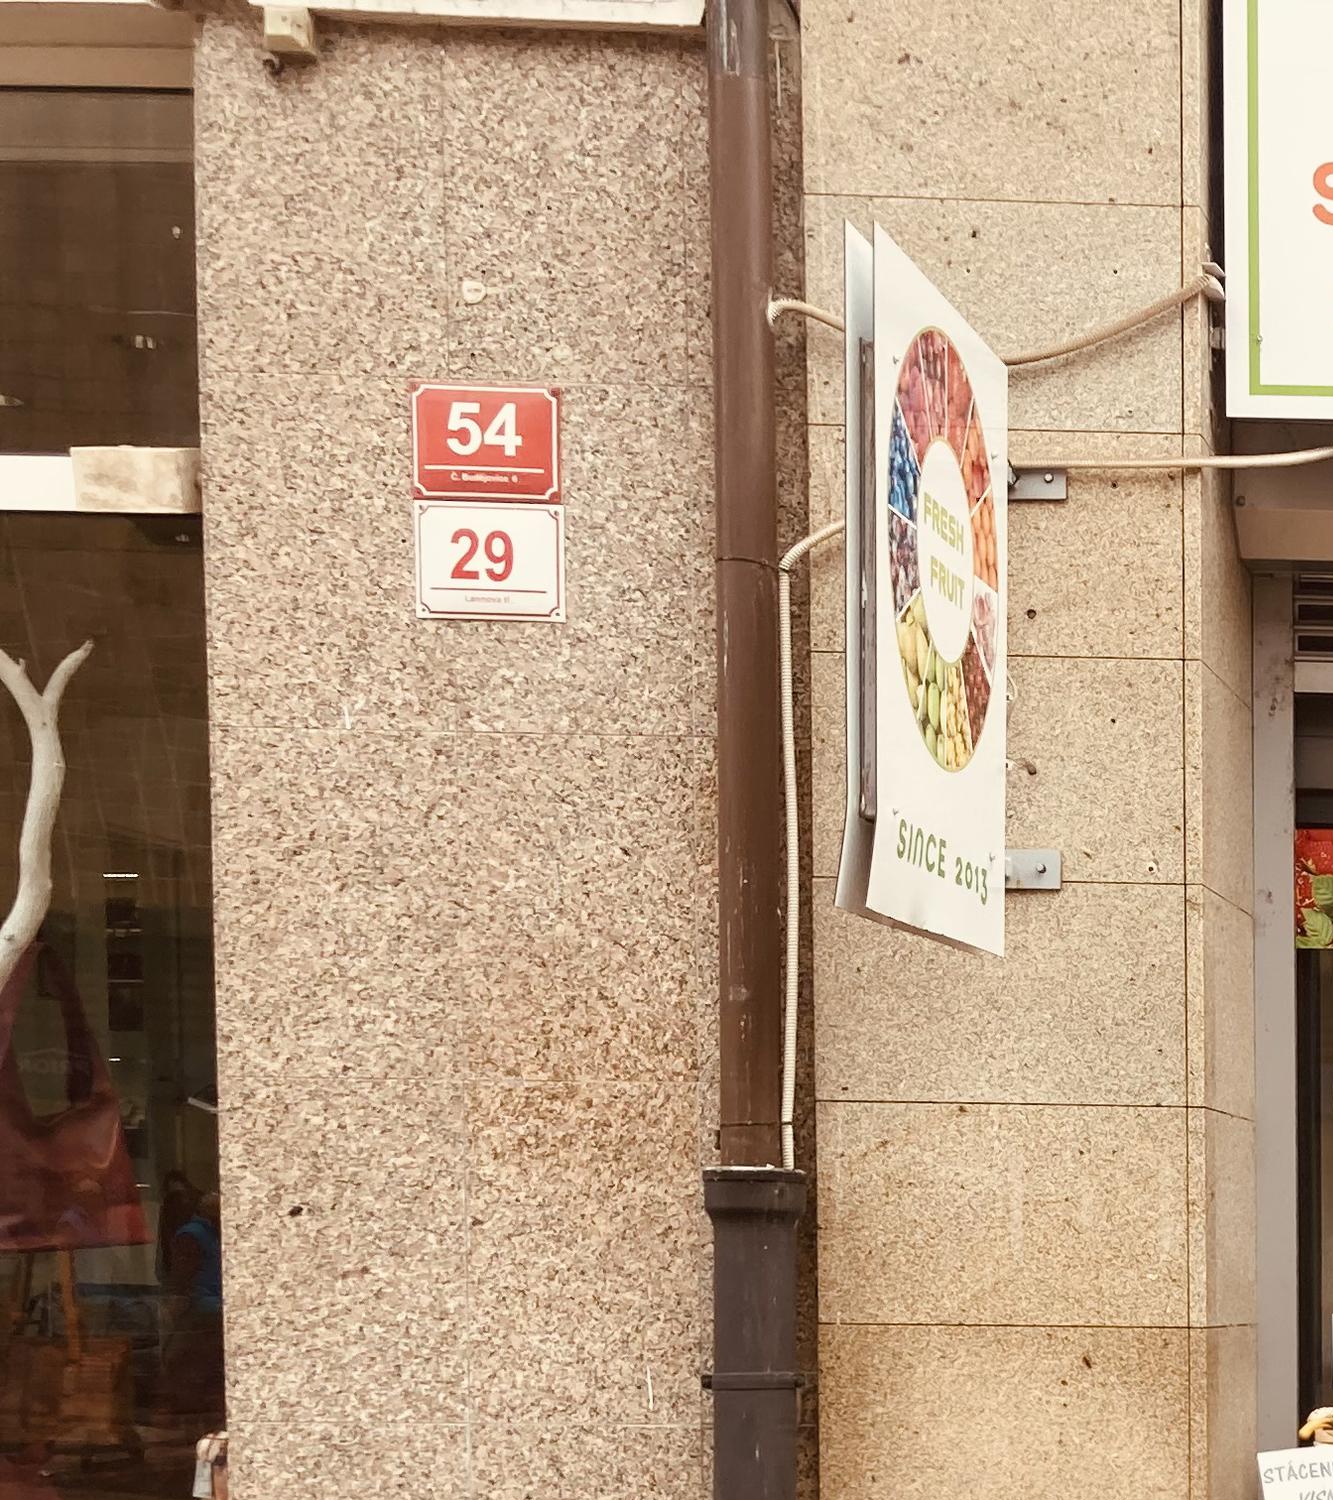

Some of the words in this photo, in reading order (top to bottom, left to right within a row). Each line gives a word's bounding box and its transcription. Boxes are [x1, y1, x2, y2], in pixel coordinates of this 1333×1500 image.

[447, 402, 522, 456] 54
[924, 492, 965, 555] FRESH
[451, 528, 513, 582] 29
[930, 556, 966, 610] FRUIT
[896, 818, 947, 879] SINCE
[955, 856, 988, 906] 2013
